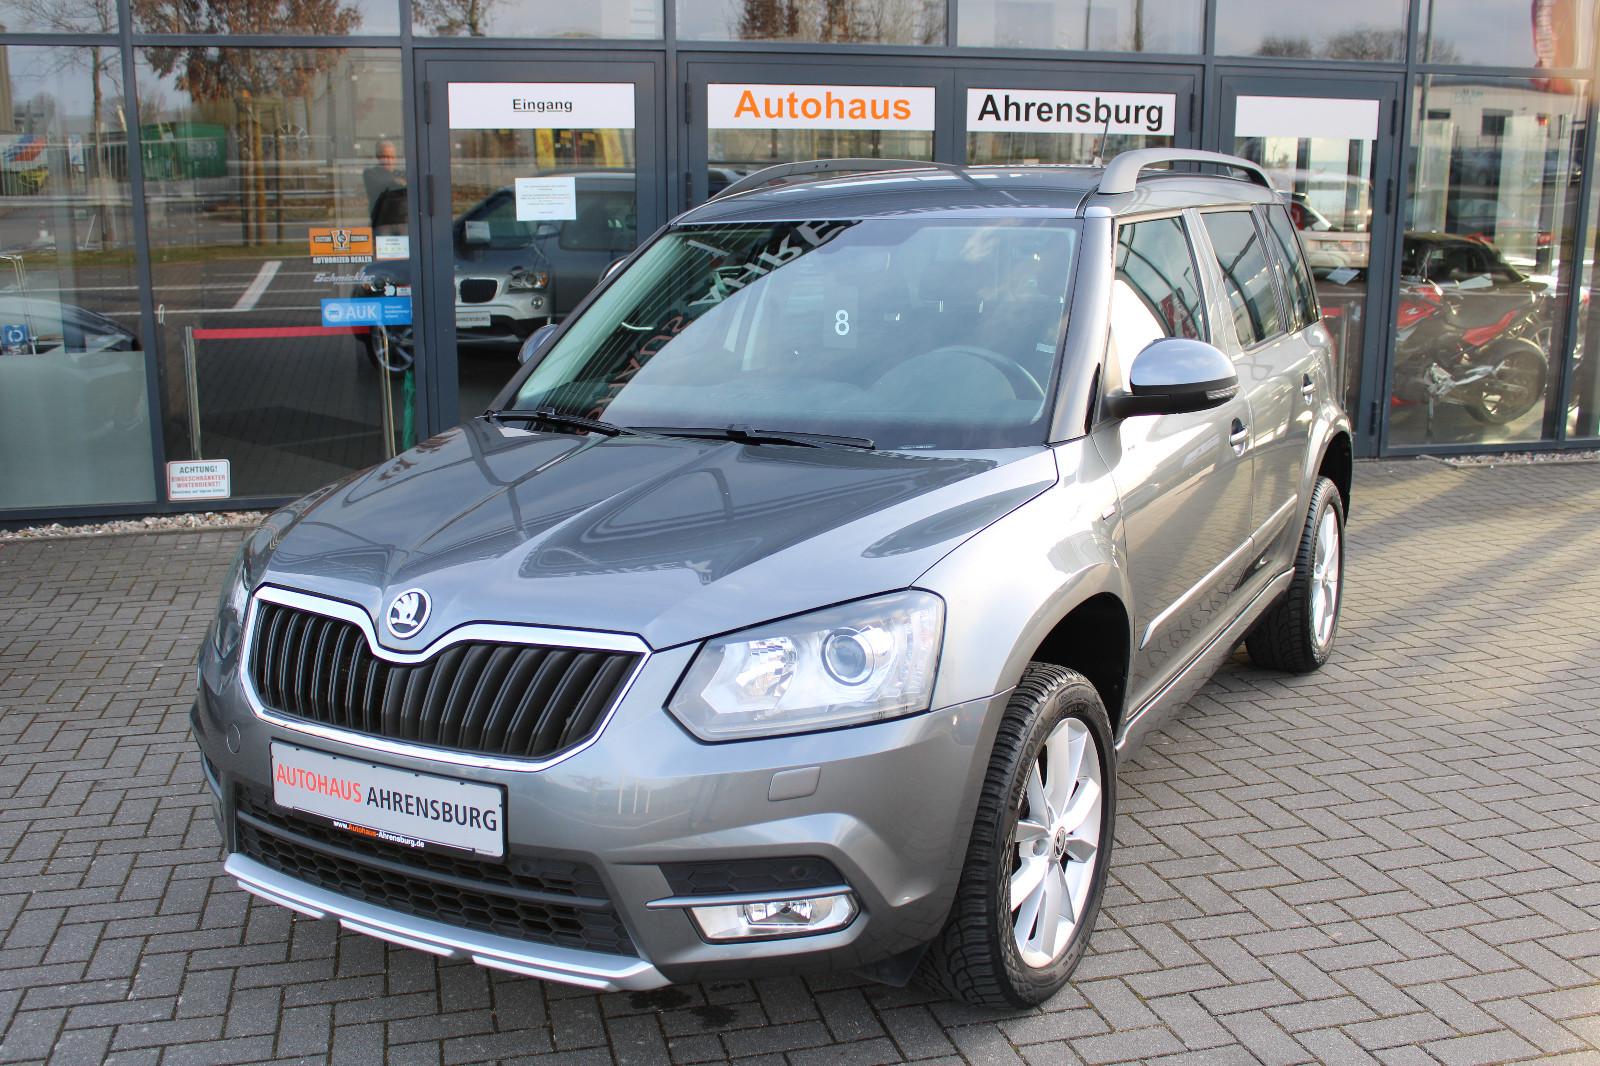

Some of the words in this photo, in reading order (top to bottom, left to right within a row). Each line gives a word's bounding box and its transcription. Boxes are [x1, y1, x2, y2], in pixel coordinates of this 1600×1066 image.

[512, 98, 573, 113] Eingang
[733, 90, 911, 120] Autohaus
[977, 94, 1163, 132] Ahrensburg
[312, 256, 349, 264] AUTHORIZED
[350, 255, 373, 263] DEALER
[346, 304, 377, 320] AUK
[834, 309, 850, 336] 8
[179, 465, 218, 474] ACHTUNG!
[276, 763, 362, 804] AUTOHAUS
[366, 786, 498, 832] AHRENSBURG
